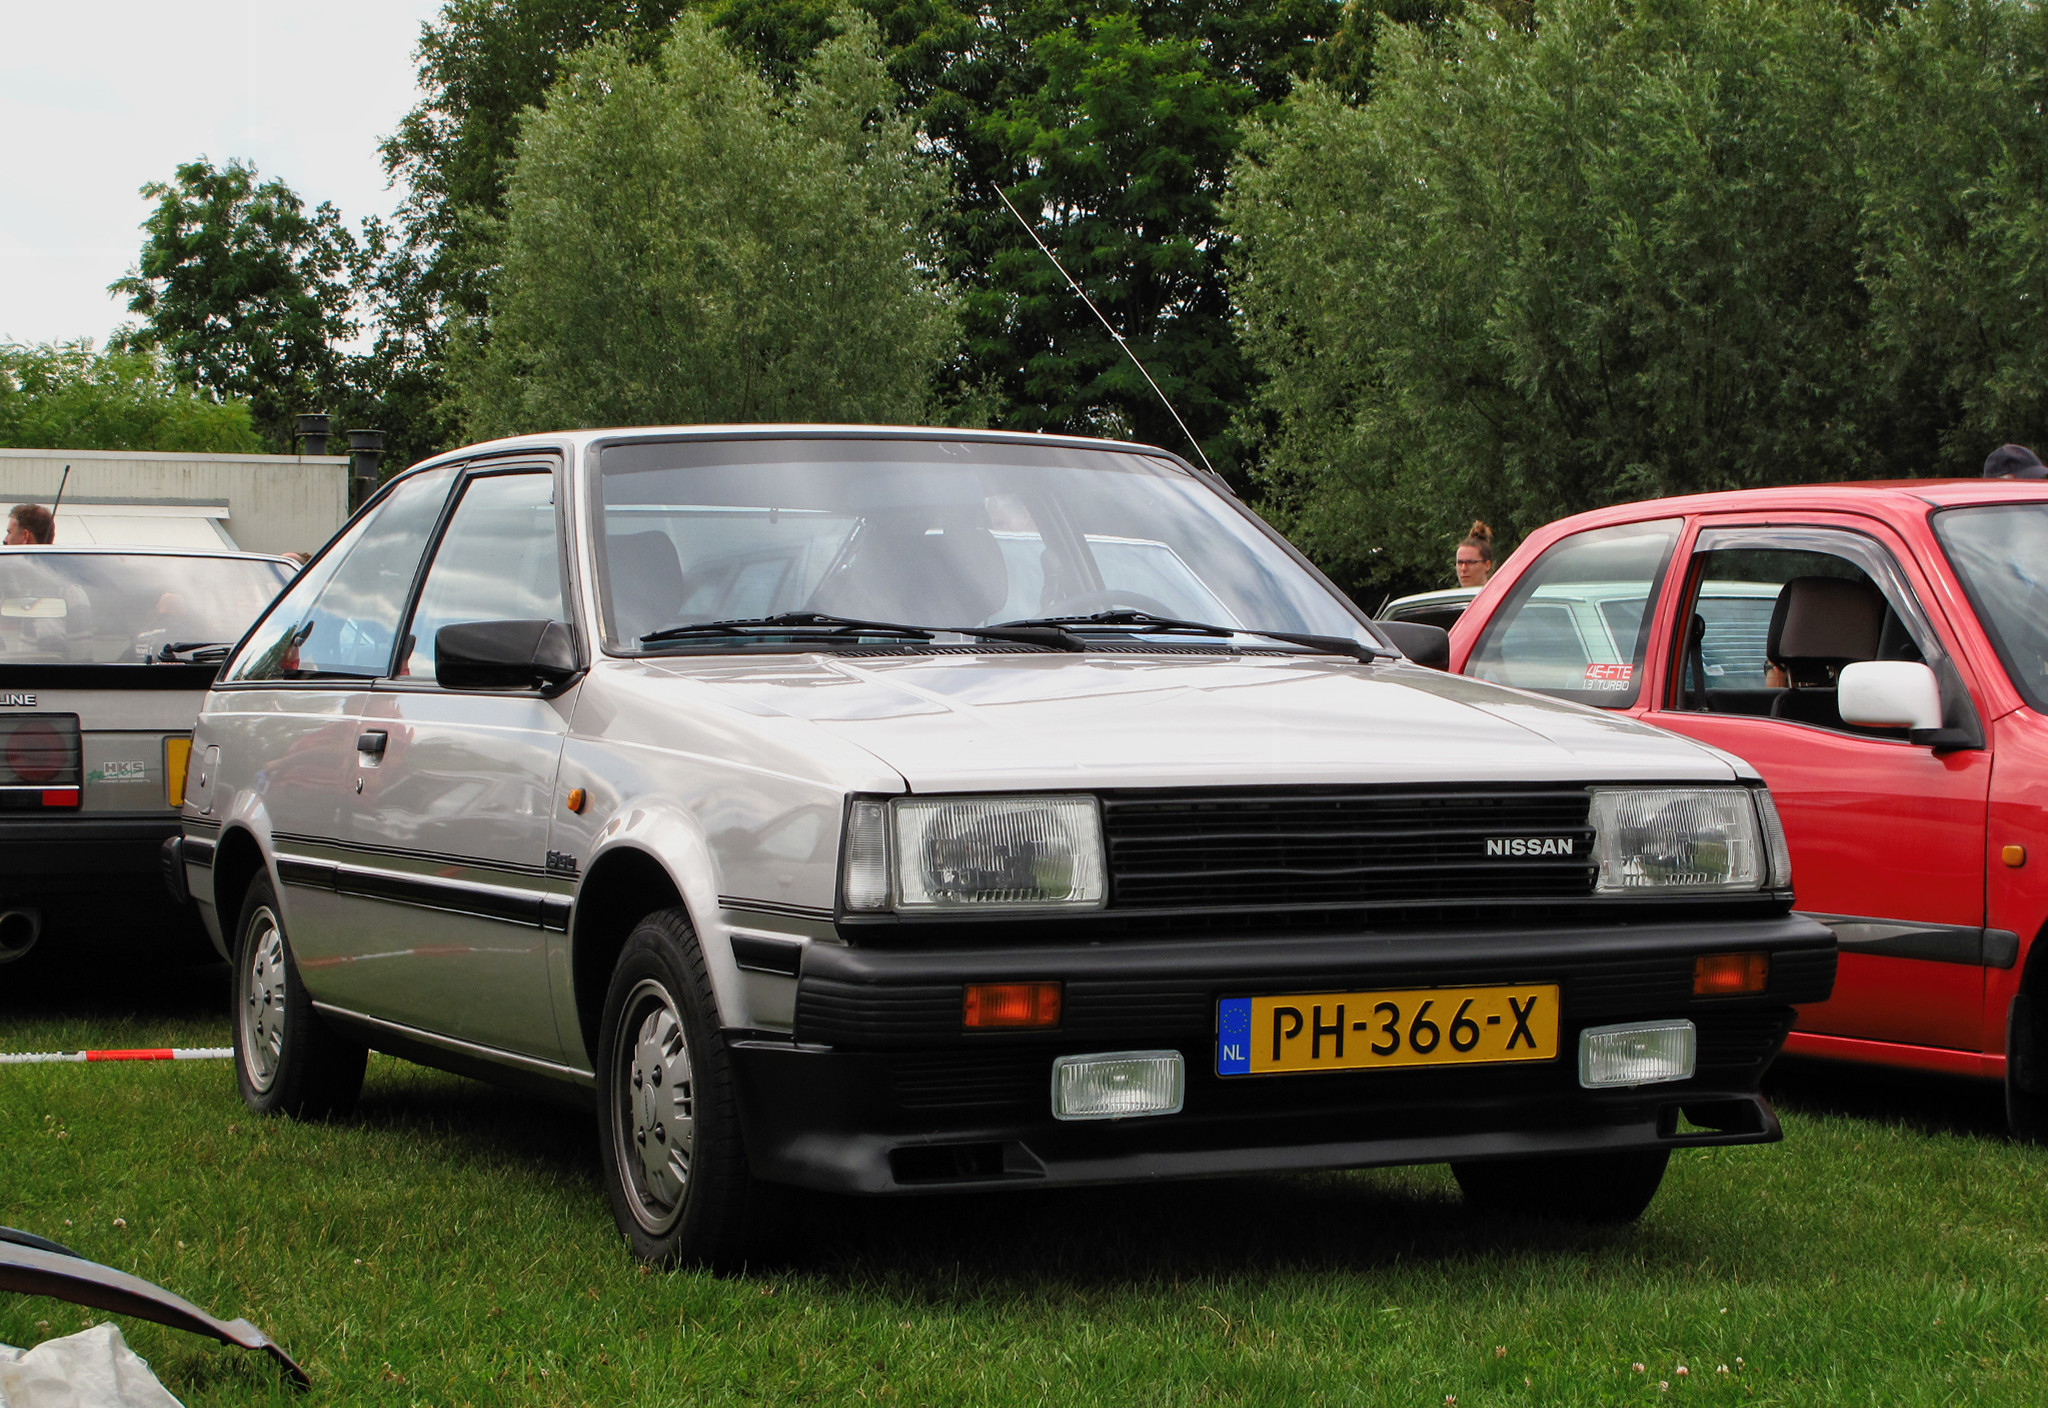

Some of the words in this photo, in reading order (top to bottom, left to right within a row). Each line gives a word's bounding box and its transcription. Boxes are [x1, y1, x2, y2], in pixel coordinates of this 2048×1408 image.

[1586, 665, 1632, 679] 4E-FTE
[1598, 680, 1630, 691] TURBO
[104, 762, 144, 777] HKS
[1487, 838, 1573, 856] NISSAN
[1272, 995, 1538, 1061] PH-366-X
[1223, 1044, 1246, 1061] NL
